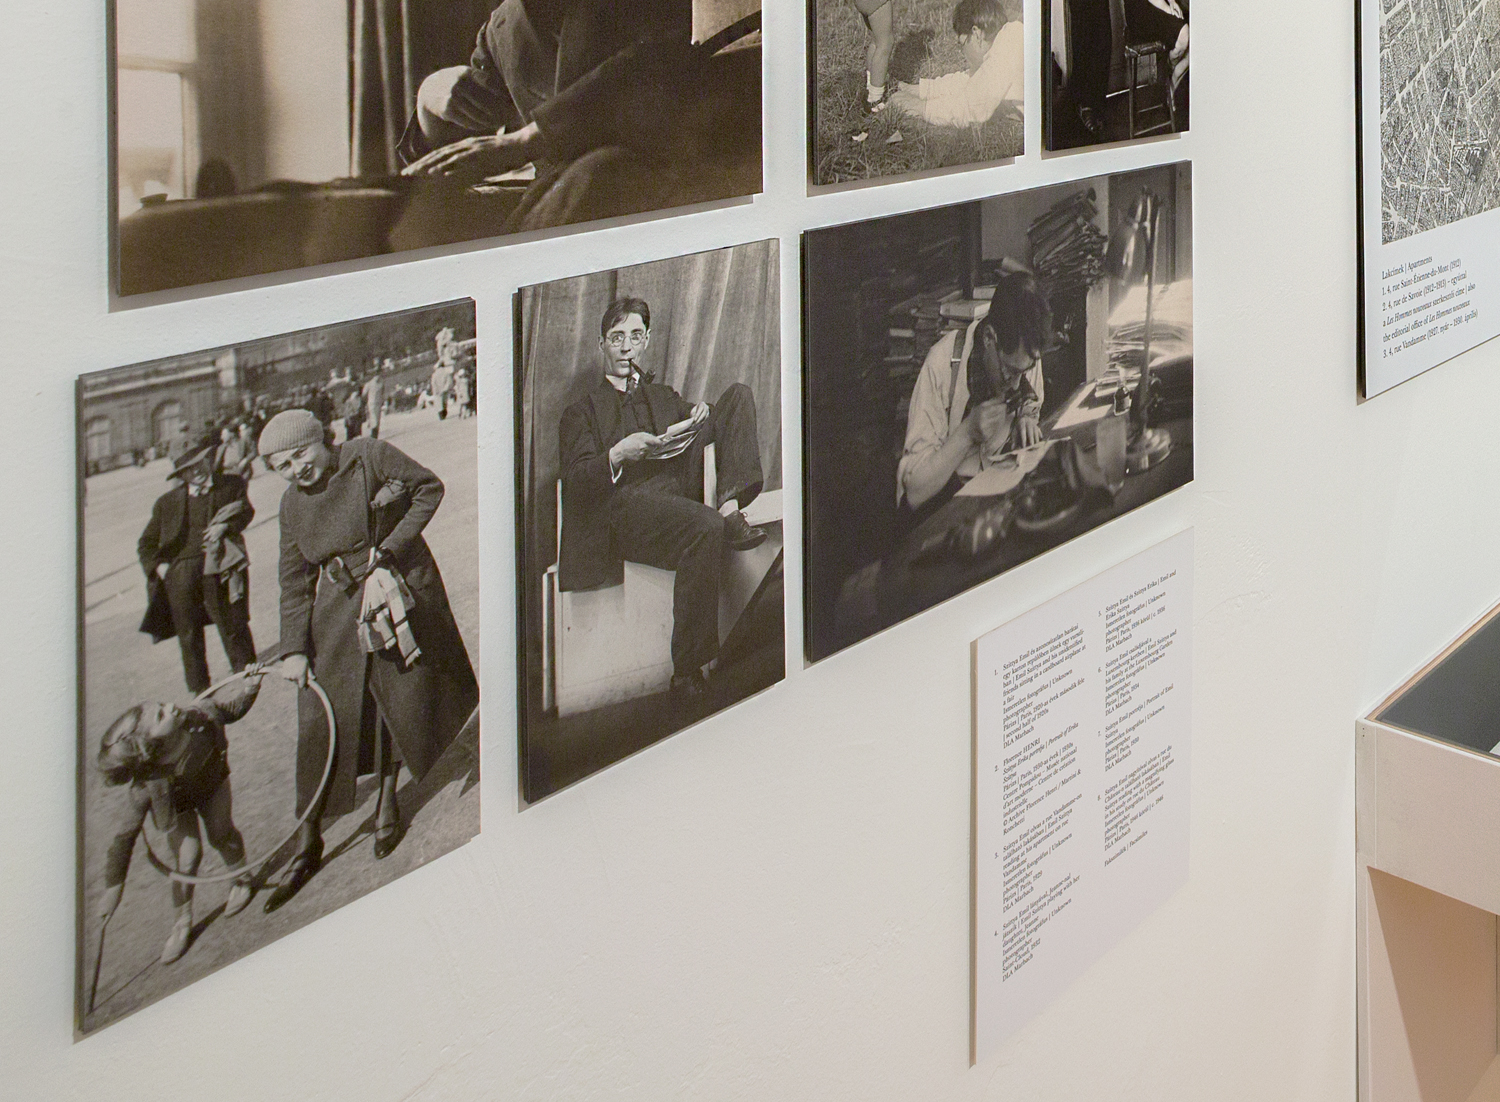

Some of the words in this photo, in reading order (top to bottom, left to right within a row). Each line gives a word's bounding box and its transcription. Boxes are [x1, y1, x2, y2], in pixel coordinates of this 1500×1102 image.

[1408, 257, 1432, 272] Apartments
[1450, 259, 1461, 271] (1912)
[1402, 295, 1407, 303] de
[1408, 289, 1422, 301] Savoie
[1392, 324, 1410, 339] editorial
[1411, 320, 1422, 330] office
[1394, 345, 1402, 353] rue
[1403, 335, 1426, 348] Vandamme
